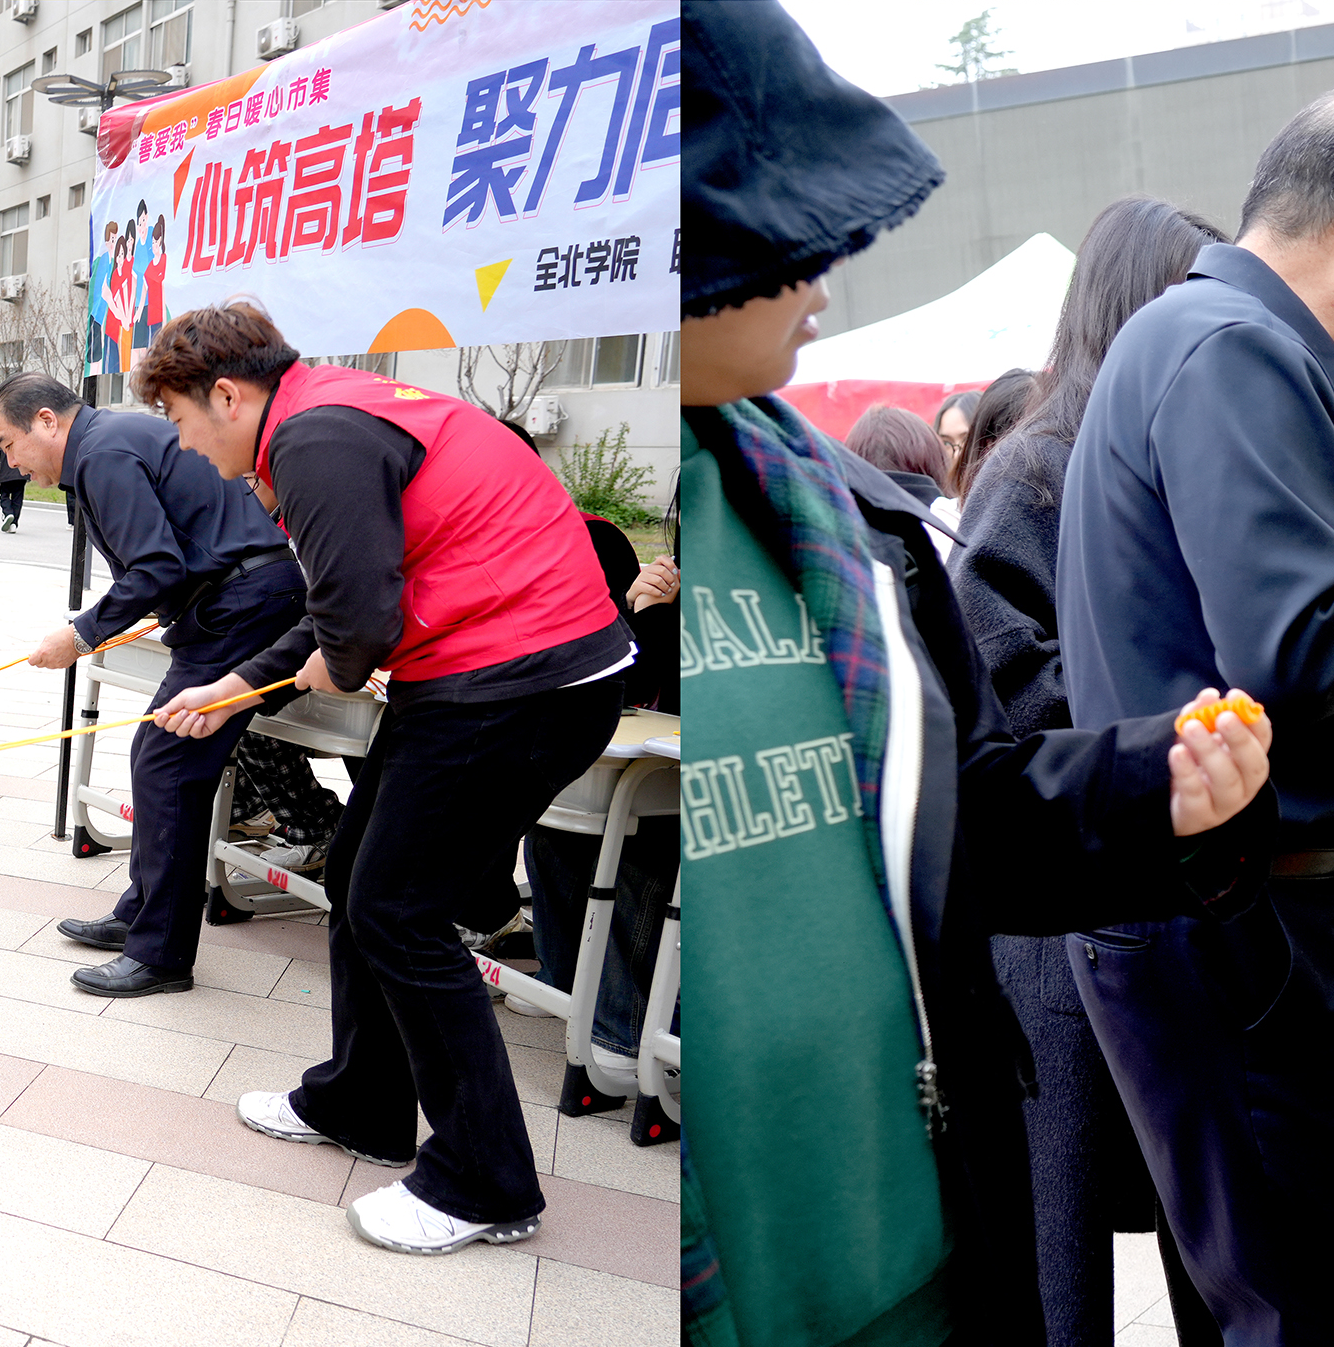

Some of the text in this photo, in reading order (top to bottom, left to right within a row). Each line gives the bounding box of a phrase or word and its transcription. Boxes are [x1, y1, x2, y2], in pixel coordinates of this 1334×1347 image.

[132, 67, 332, 164] “善爱我” 春日暖心市集
[181, 96, 422, 277] 心筑高塔
[533, 235, 641, 292] 全北学院
